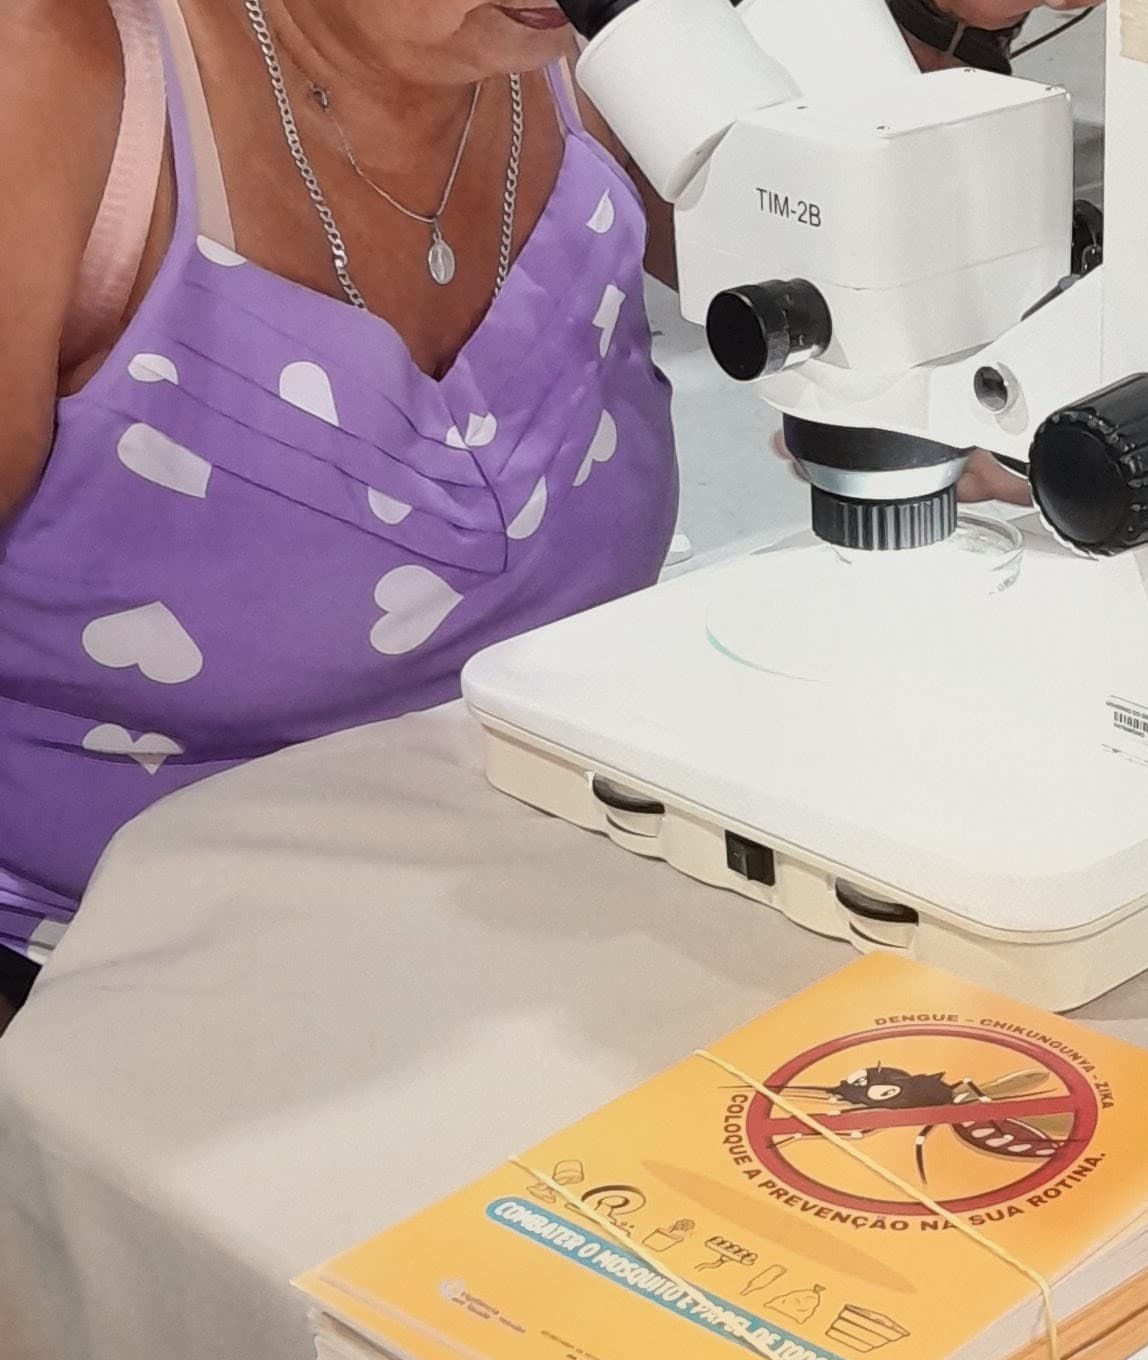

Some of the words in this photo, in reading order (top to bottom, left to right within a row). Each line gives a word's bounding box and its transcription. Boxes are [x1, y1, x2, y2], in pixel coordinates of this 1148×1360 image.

[756, 187, 822, 228] TIM-2B
[873, 1013, 960, 1027] DENGUE
[979, 1017, 1097, 1074] CHIKUNGUNYA
[1094, 1080, 1115, 1110] ZIKA
[723, 1093, 753, 1166] COLOQUE
[743, 1168, 763, 1180] A
[757, 1179, 910, 1232] PREVENÇÃO
[920, 1220, 959, 1232] NA
[968, 1204, 1025, 1227] SUA
[1026, 1152, 1107, 1208] ROTINA.
[494, 1200, 586, 1252] COMBATER
[577, 1242, 601, 1259] O
[591, 1249, 684, 1303] MOSQUITO
